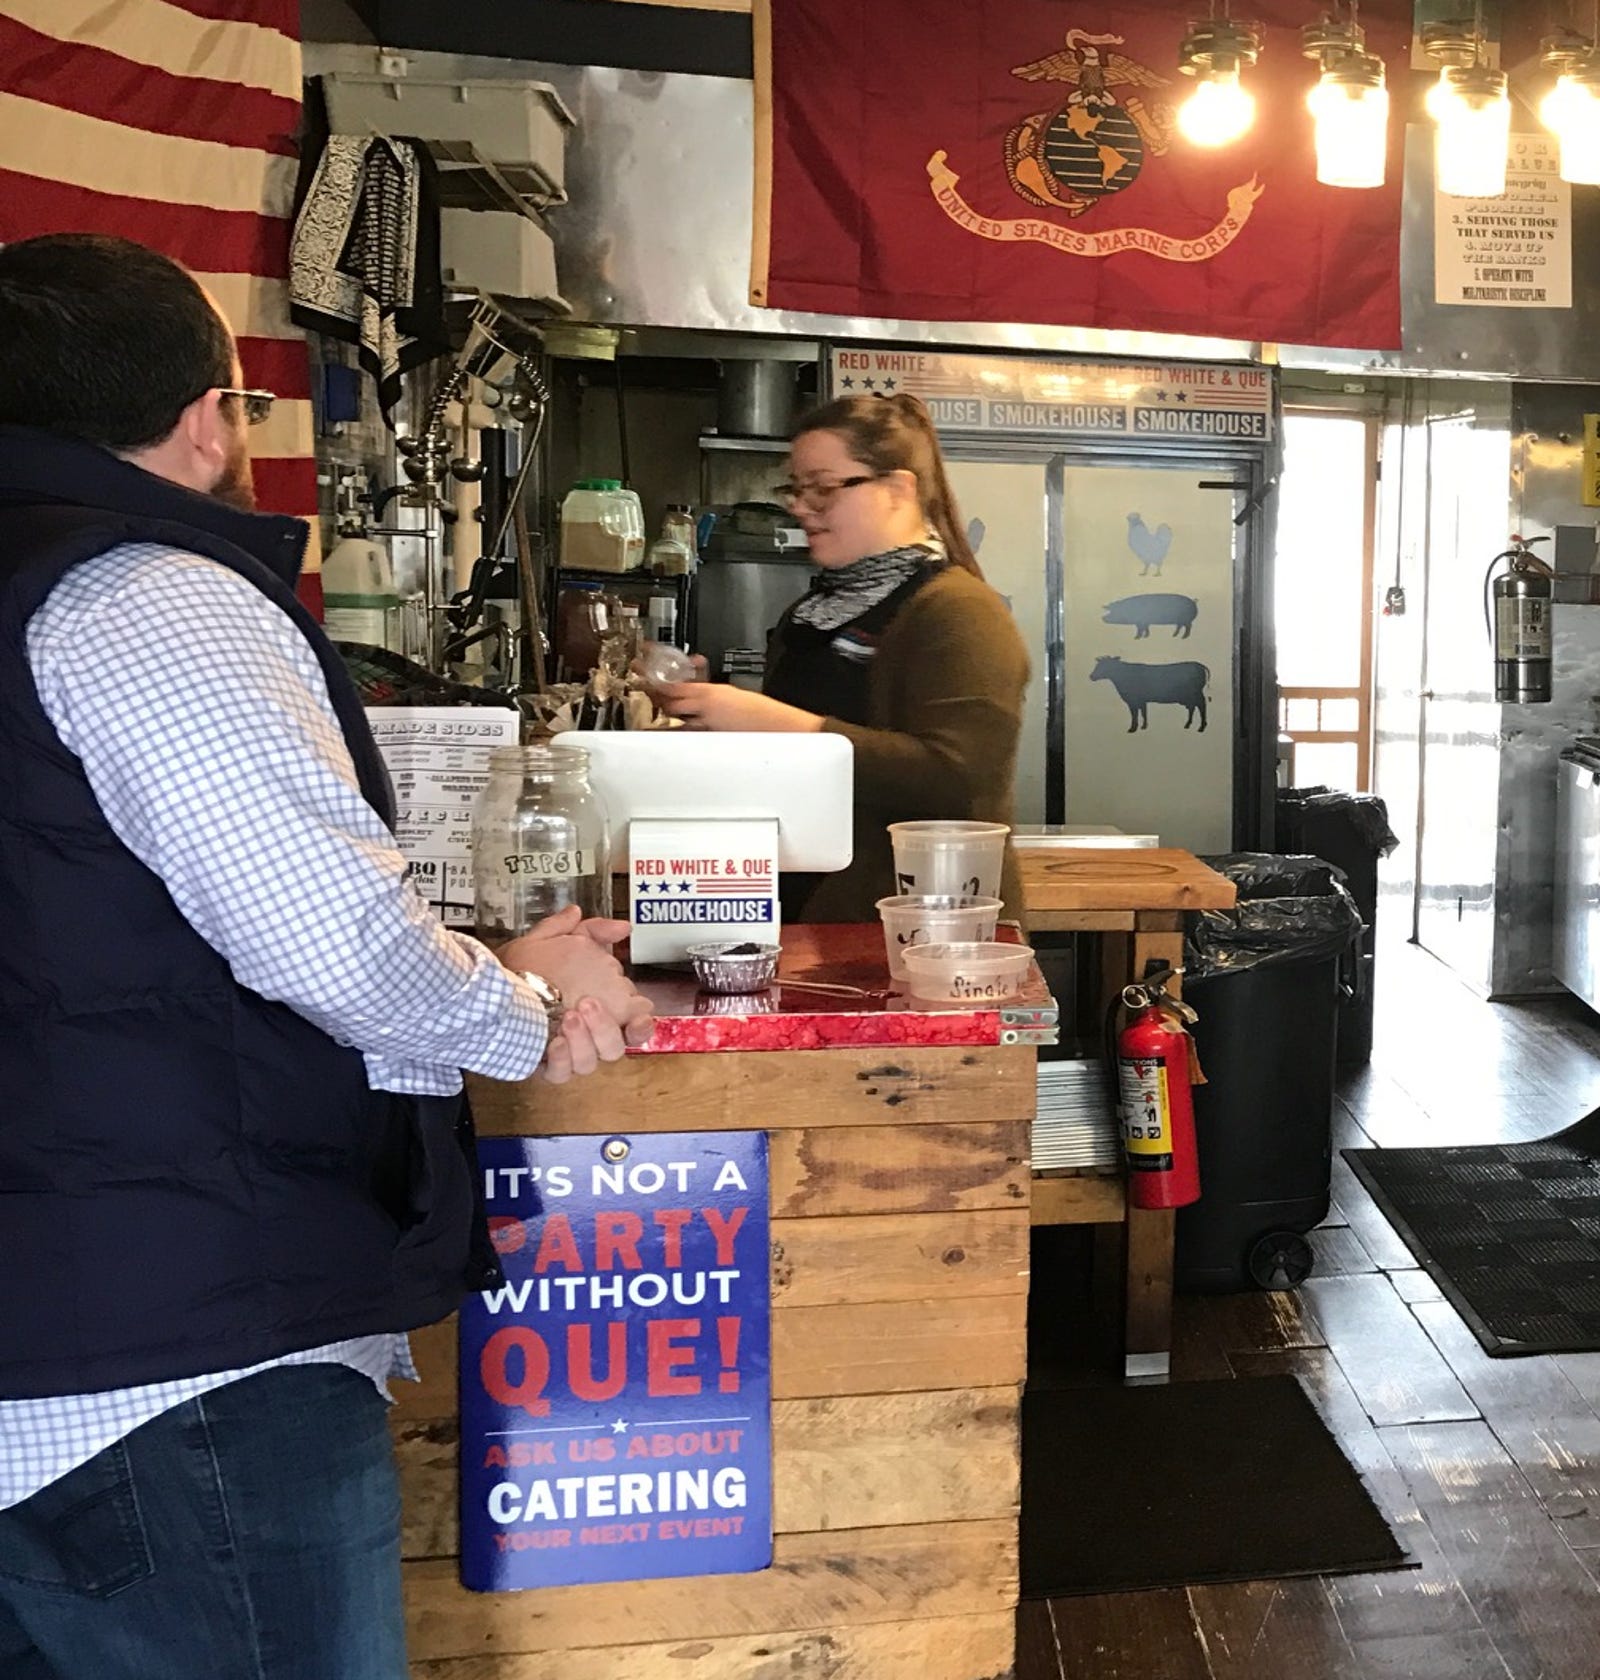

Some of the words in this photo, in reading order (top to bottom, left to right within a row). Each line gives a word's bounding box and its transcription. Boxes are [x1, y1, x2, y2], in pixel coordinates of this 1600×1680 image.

[937, 186, 1003, 238] UNITED
[1013, 223, 1087, 252] STATES
[1093, 231, 1173, 255] MARINE
[1180, 218, 1239, 260] CORPS
[1467, 216, 1517, 227] SERVING
[1521, 217, 1559, 228] THOSE
[1457, 228, 1487, 239] THAT
[1491, 229, 1536, 240] SERVED
[1539, 230, 1555, 241] US
[1462, 254, 1493, 264] THE
[1480, 242, 1522, 252] MOVE
[1526, 243, 1544, 253] UP
[1482, 268, 1513, 282] OPERATE
[1515, 269, 1534, 282] WITH
[839, 352, 869, 370] RED
[876, 353, 925, 372] WHITE
[1168, 368, 1216, 385] WHITE
[1221, 369, 1233, 386] &
[1239, 371, 1267, 388] QUE
[993, 404, 1123, 429] SMOKEHOUSE
[1137, 409, 1264, 436] SMOKEHOUSE
[441, 722, 504, 737] SIDES
[504, 852, 583, 875] TIPS!
[635, 859, 666, 876] RED
[670, 859, 720, 876] WHITE
[724, 859, 738, 876] &
[743, 859, 772, 877] QUE
[640, 900, 768, 922] SMOKEHOUSE
[484, 1165, 571, 1200] IT'S
[592, 1161, 698, 1196] NOT
[713, 1160, 748, 1192] A
[488, 1206, 749, 1274] PARTY
[480, 1270, 741, 1315] WITHOUT
[479, 1316, 742, 1418] QUE!
[483, 1438, 557, 1469] ASK
[568, 1435, 617, 1463] US
[625, 1430, 744, 1460] ABOUT
[487, 1466, 748, 1525] CATERING
[492, 1530, 572, 1553] YOUR
[579, 1522, 652, 1548] NEXT
[658, 1516, 745, 1542] EVENT
